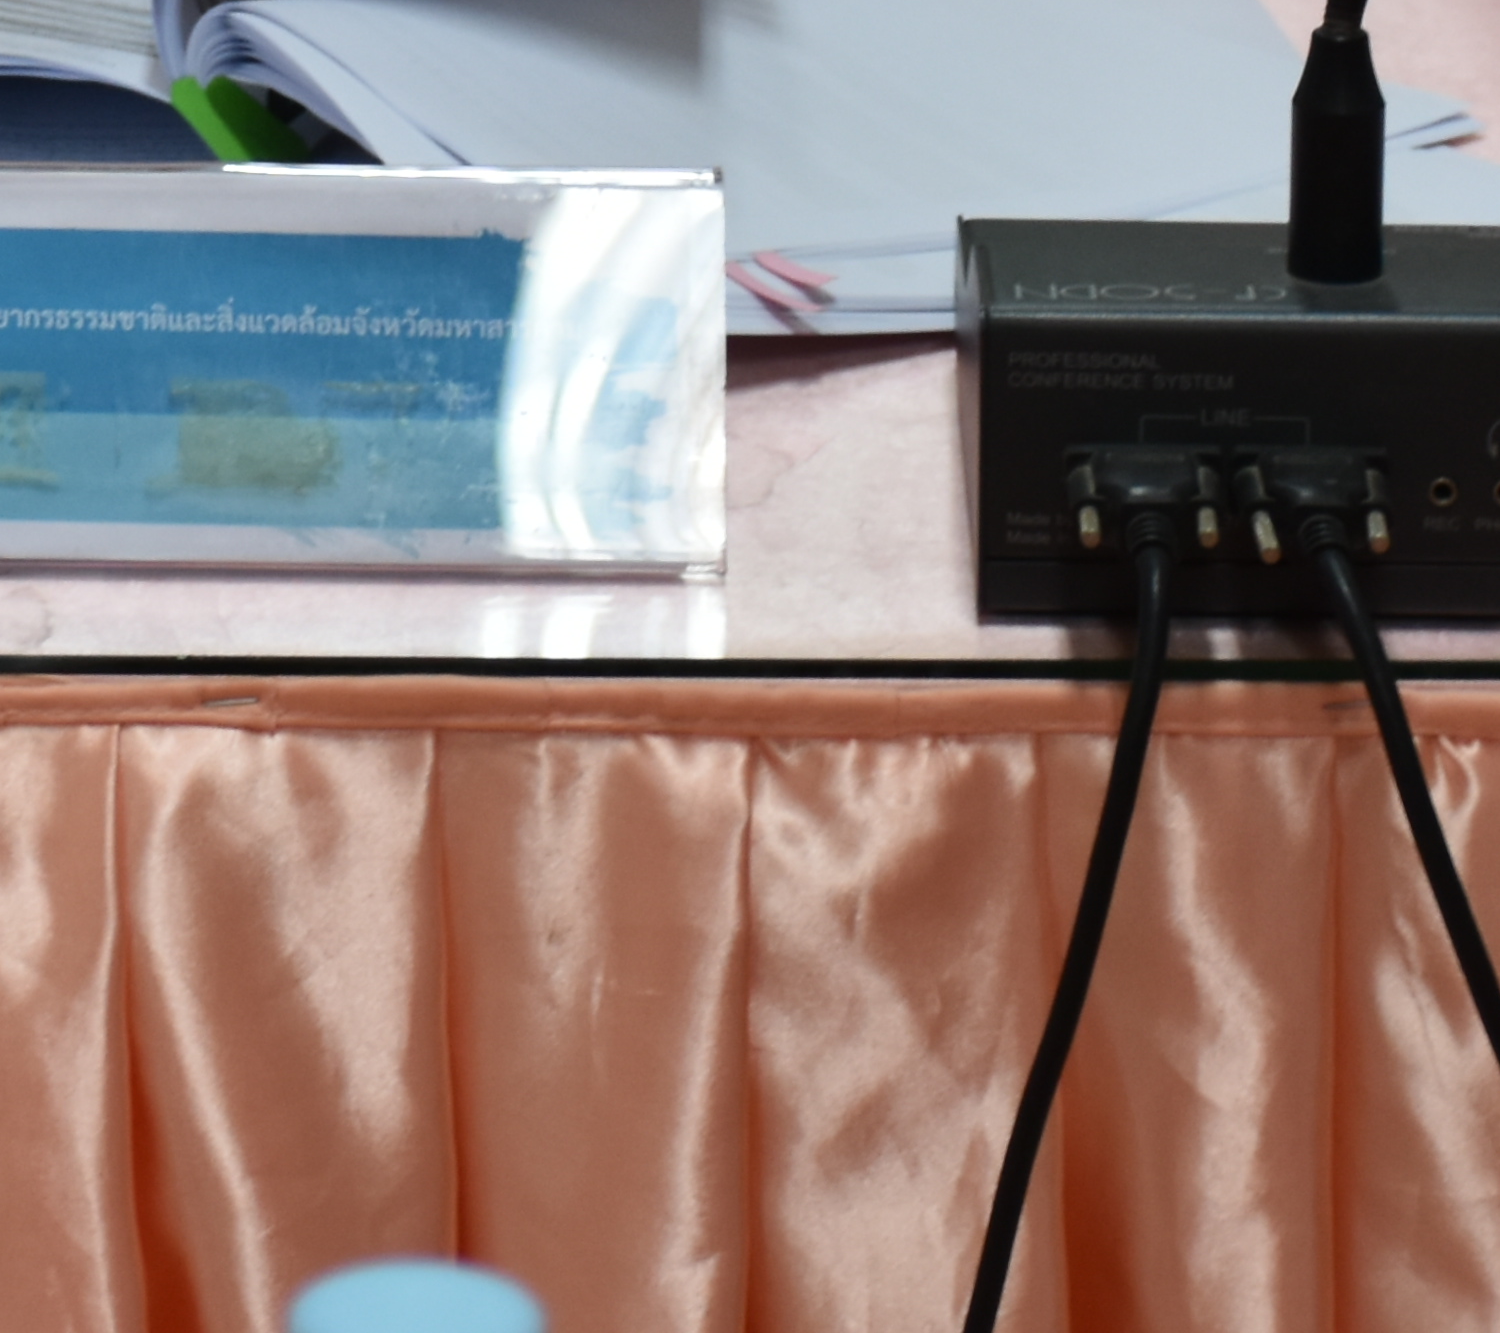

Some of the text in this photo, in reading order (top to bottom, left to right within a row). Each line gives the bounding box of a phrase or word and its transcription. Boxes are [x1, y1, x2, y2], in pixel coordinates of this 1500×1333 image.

[1007, 351, 1161, 370] PROFESSIONAL
[1007, 372, 1235, 391] CONFERENCE SYSTEM
[1199, 408, 1252, 427] LINE
[1422, 515, 1461, 533] REC
